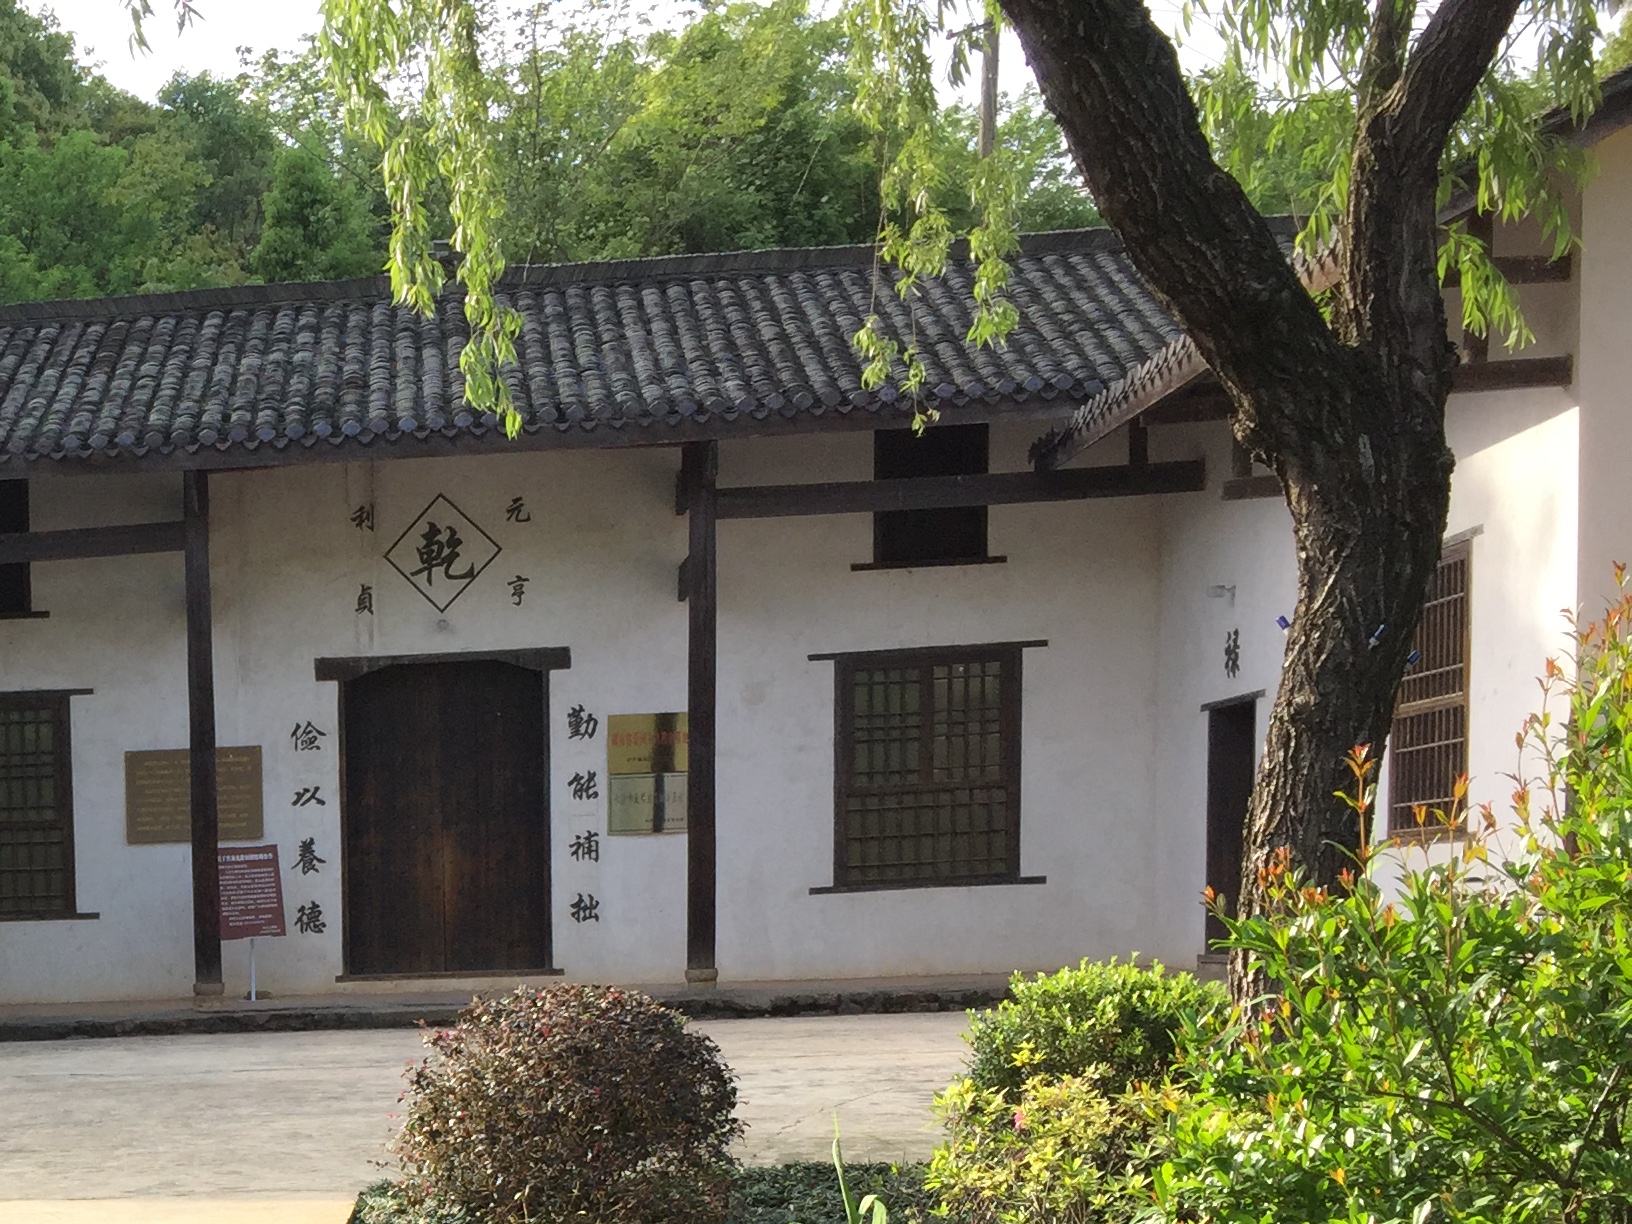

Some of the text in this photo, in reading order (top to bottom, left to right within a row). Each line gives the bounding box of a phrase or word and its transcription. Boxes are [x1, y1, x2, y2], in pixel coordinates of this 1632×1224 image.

[410, 522, 474, 586] 乾
[567, 704, 599, 923] 勤能補拙
